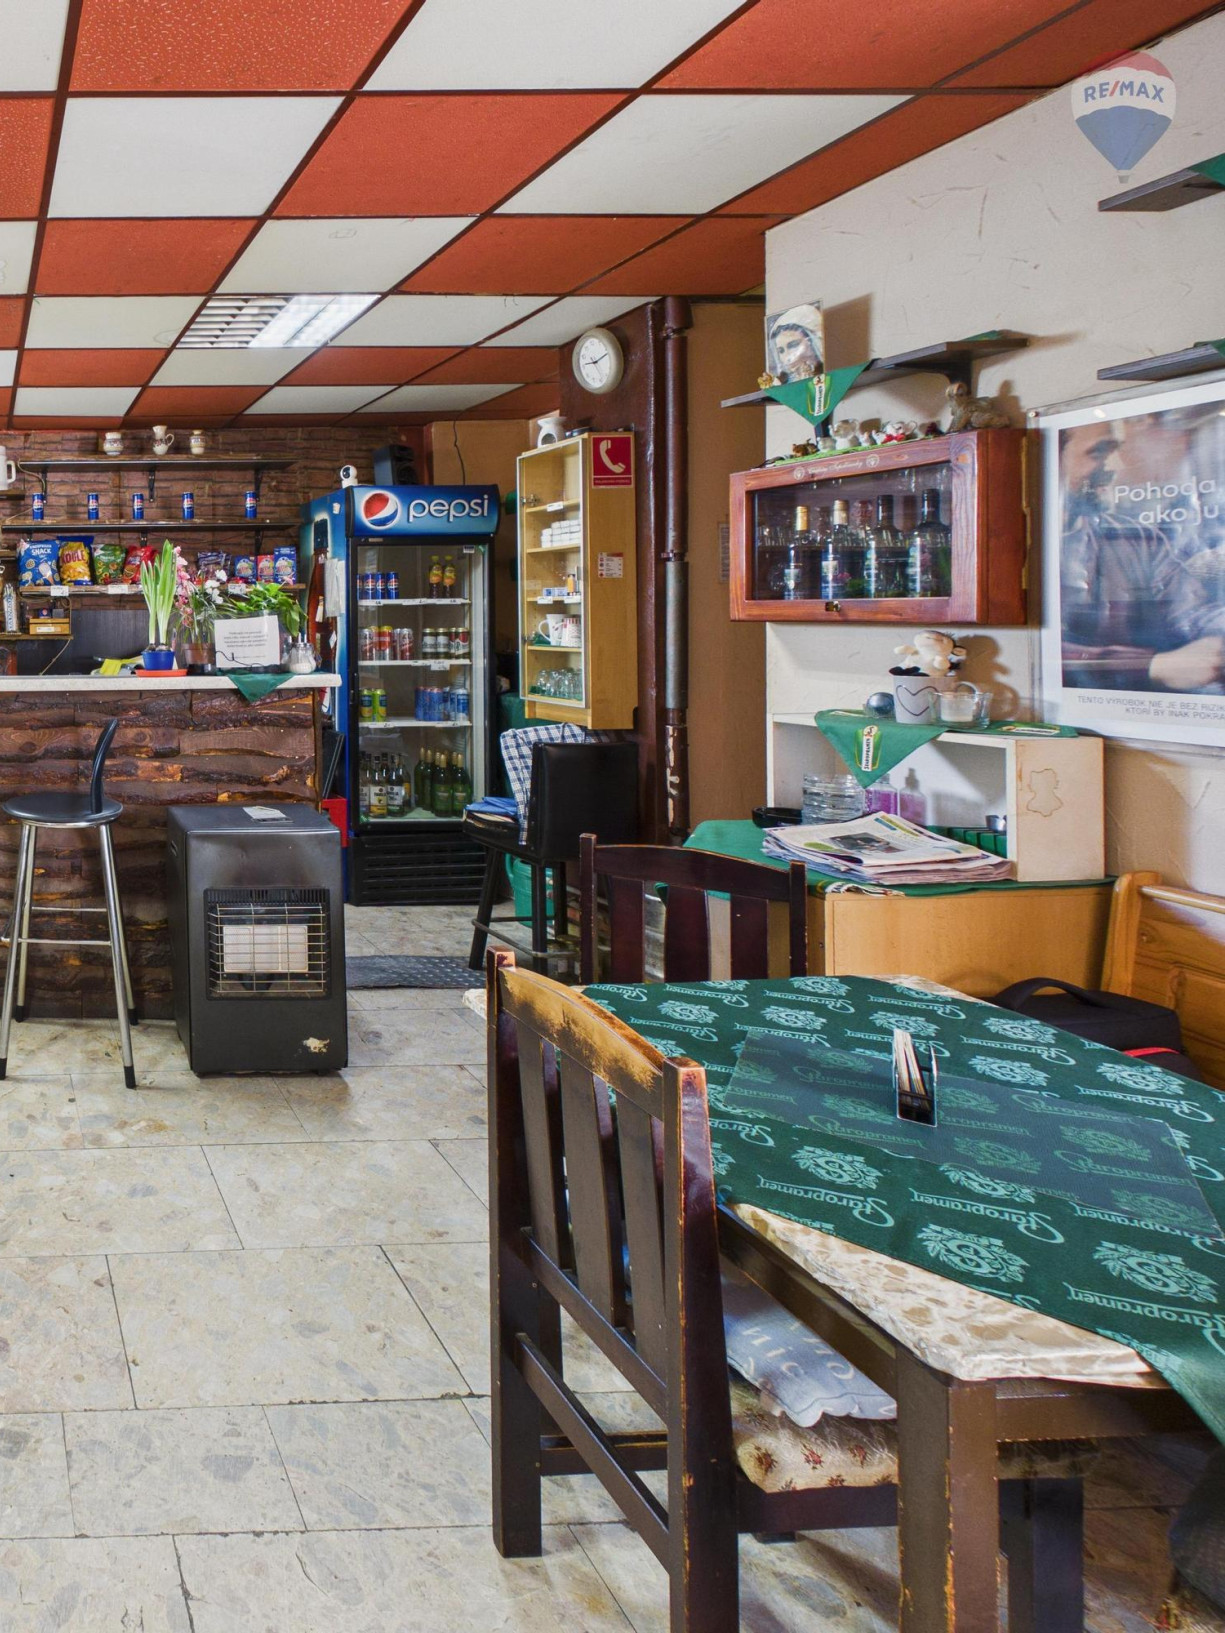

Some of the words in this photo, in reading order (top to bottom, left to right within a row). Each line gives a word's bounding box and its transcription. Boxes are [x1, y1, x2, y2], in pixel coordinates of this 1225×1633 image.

[1115, 476, 1216, 503] Pohoda
[409, 494, 488, 522] pepsi
[1138, 504, 1187, 524] ako
[1180, 702, 1197, 711] BEZ
[960, 1035, 1076, 1066] Staropramen
[1075, 1085, 1216, 1123] Staropramen
[757, 1174, 895, 1228] Staropramen
[909, 1188, 1065, 1244] Staropramen
